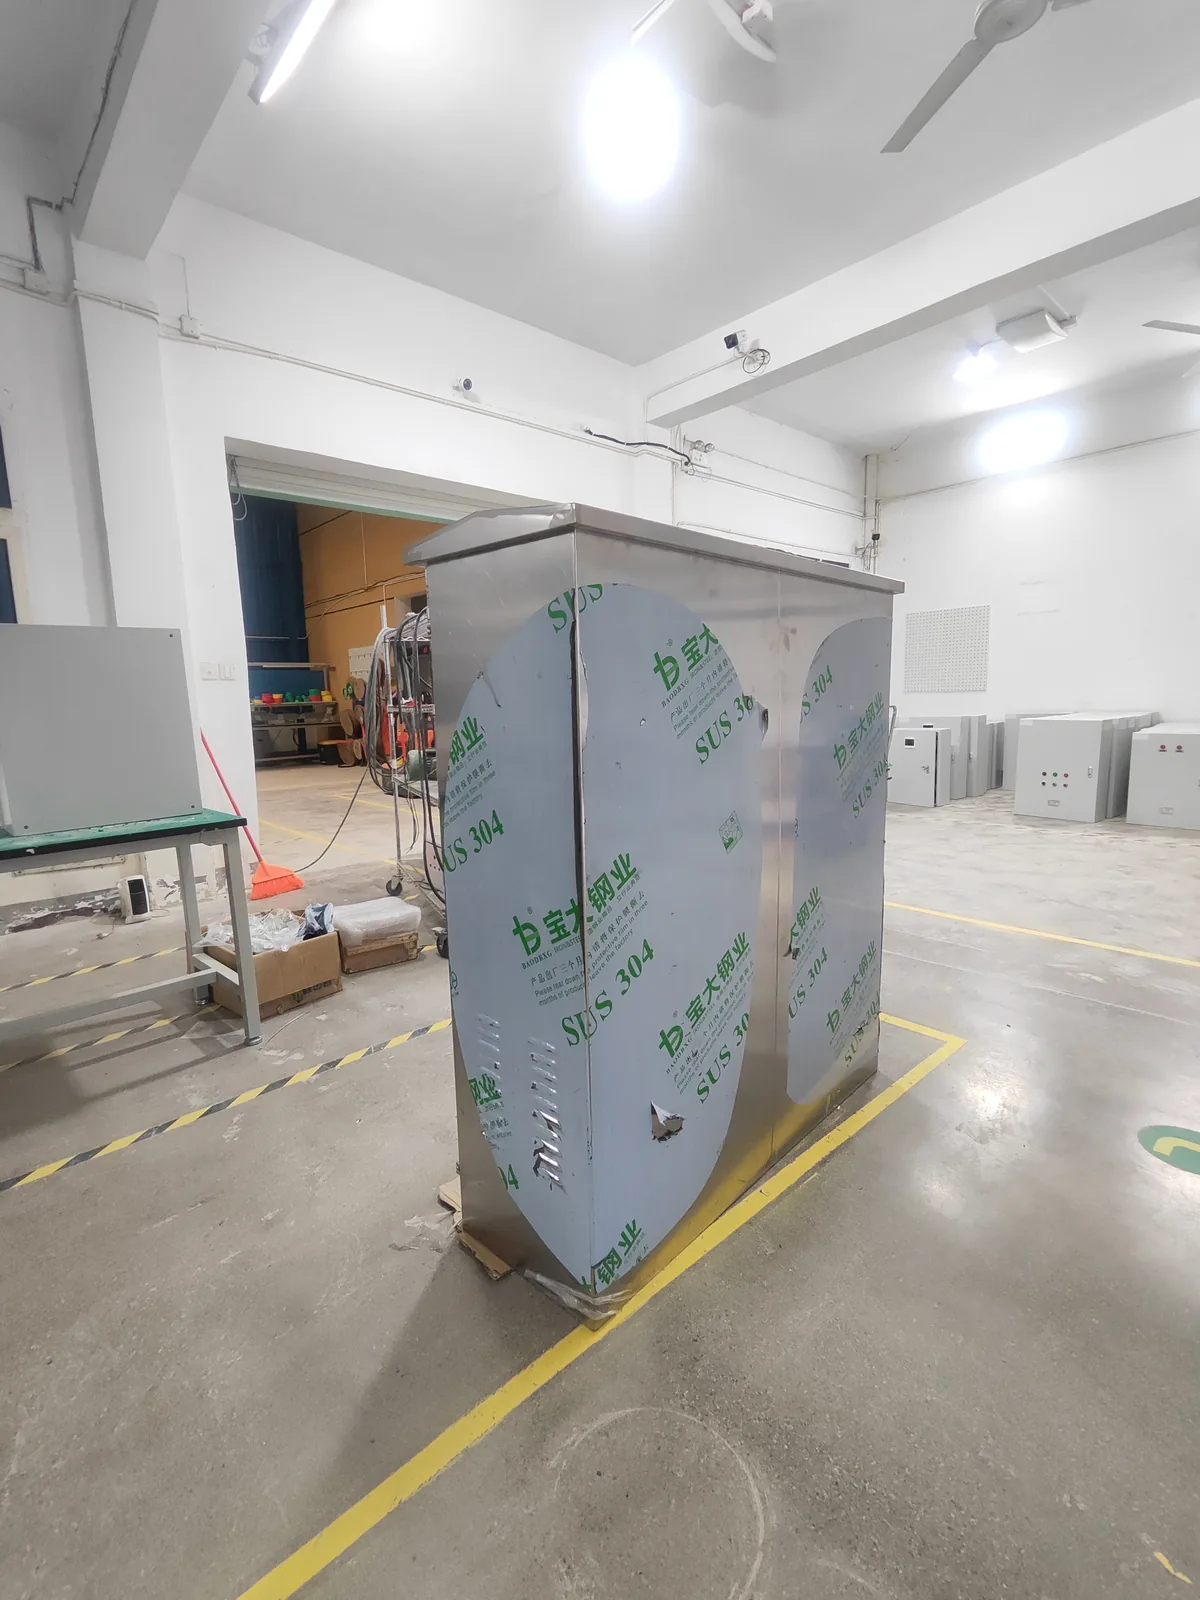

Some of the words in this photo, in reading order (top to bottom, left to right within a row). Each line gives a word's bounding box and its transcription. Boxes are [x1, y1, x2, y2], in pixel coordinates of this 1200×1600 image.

[812, 664, 833, 703] 304
[695, 711, 732, 765] SUS
[848, 691, 885, 755] 宝大钢业
[852, 778, 873, 820] SUS
[468, 809, 504, 853] 304
[521, 950, 553, 969] BAODBXG
[534, 985, 553, 998] Please
[552, 980, 565, 990] tear
[564, 973, 579, 985] down
[590, 935, 619, 970] protective
[617, 922, 629, 936] film
[627, 915, 635, 924] in
[633, 899, 649, 917] three
[589, 961, 606, 981] leave
[605, 950, 616, 962] the
[614, 928, 635, 952] factory
[809, 947, 829, 988] 304
[561, 990, 613, 1046] SUS
[615, 938, 655, 996] 304
[685, 932, 749, 1029] 宝大钢业
[697, 1044, 732, 1104] SUS
